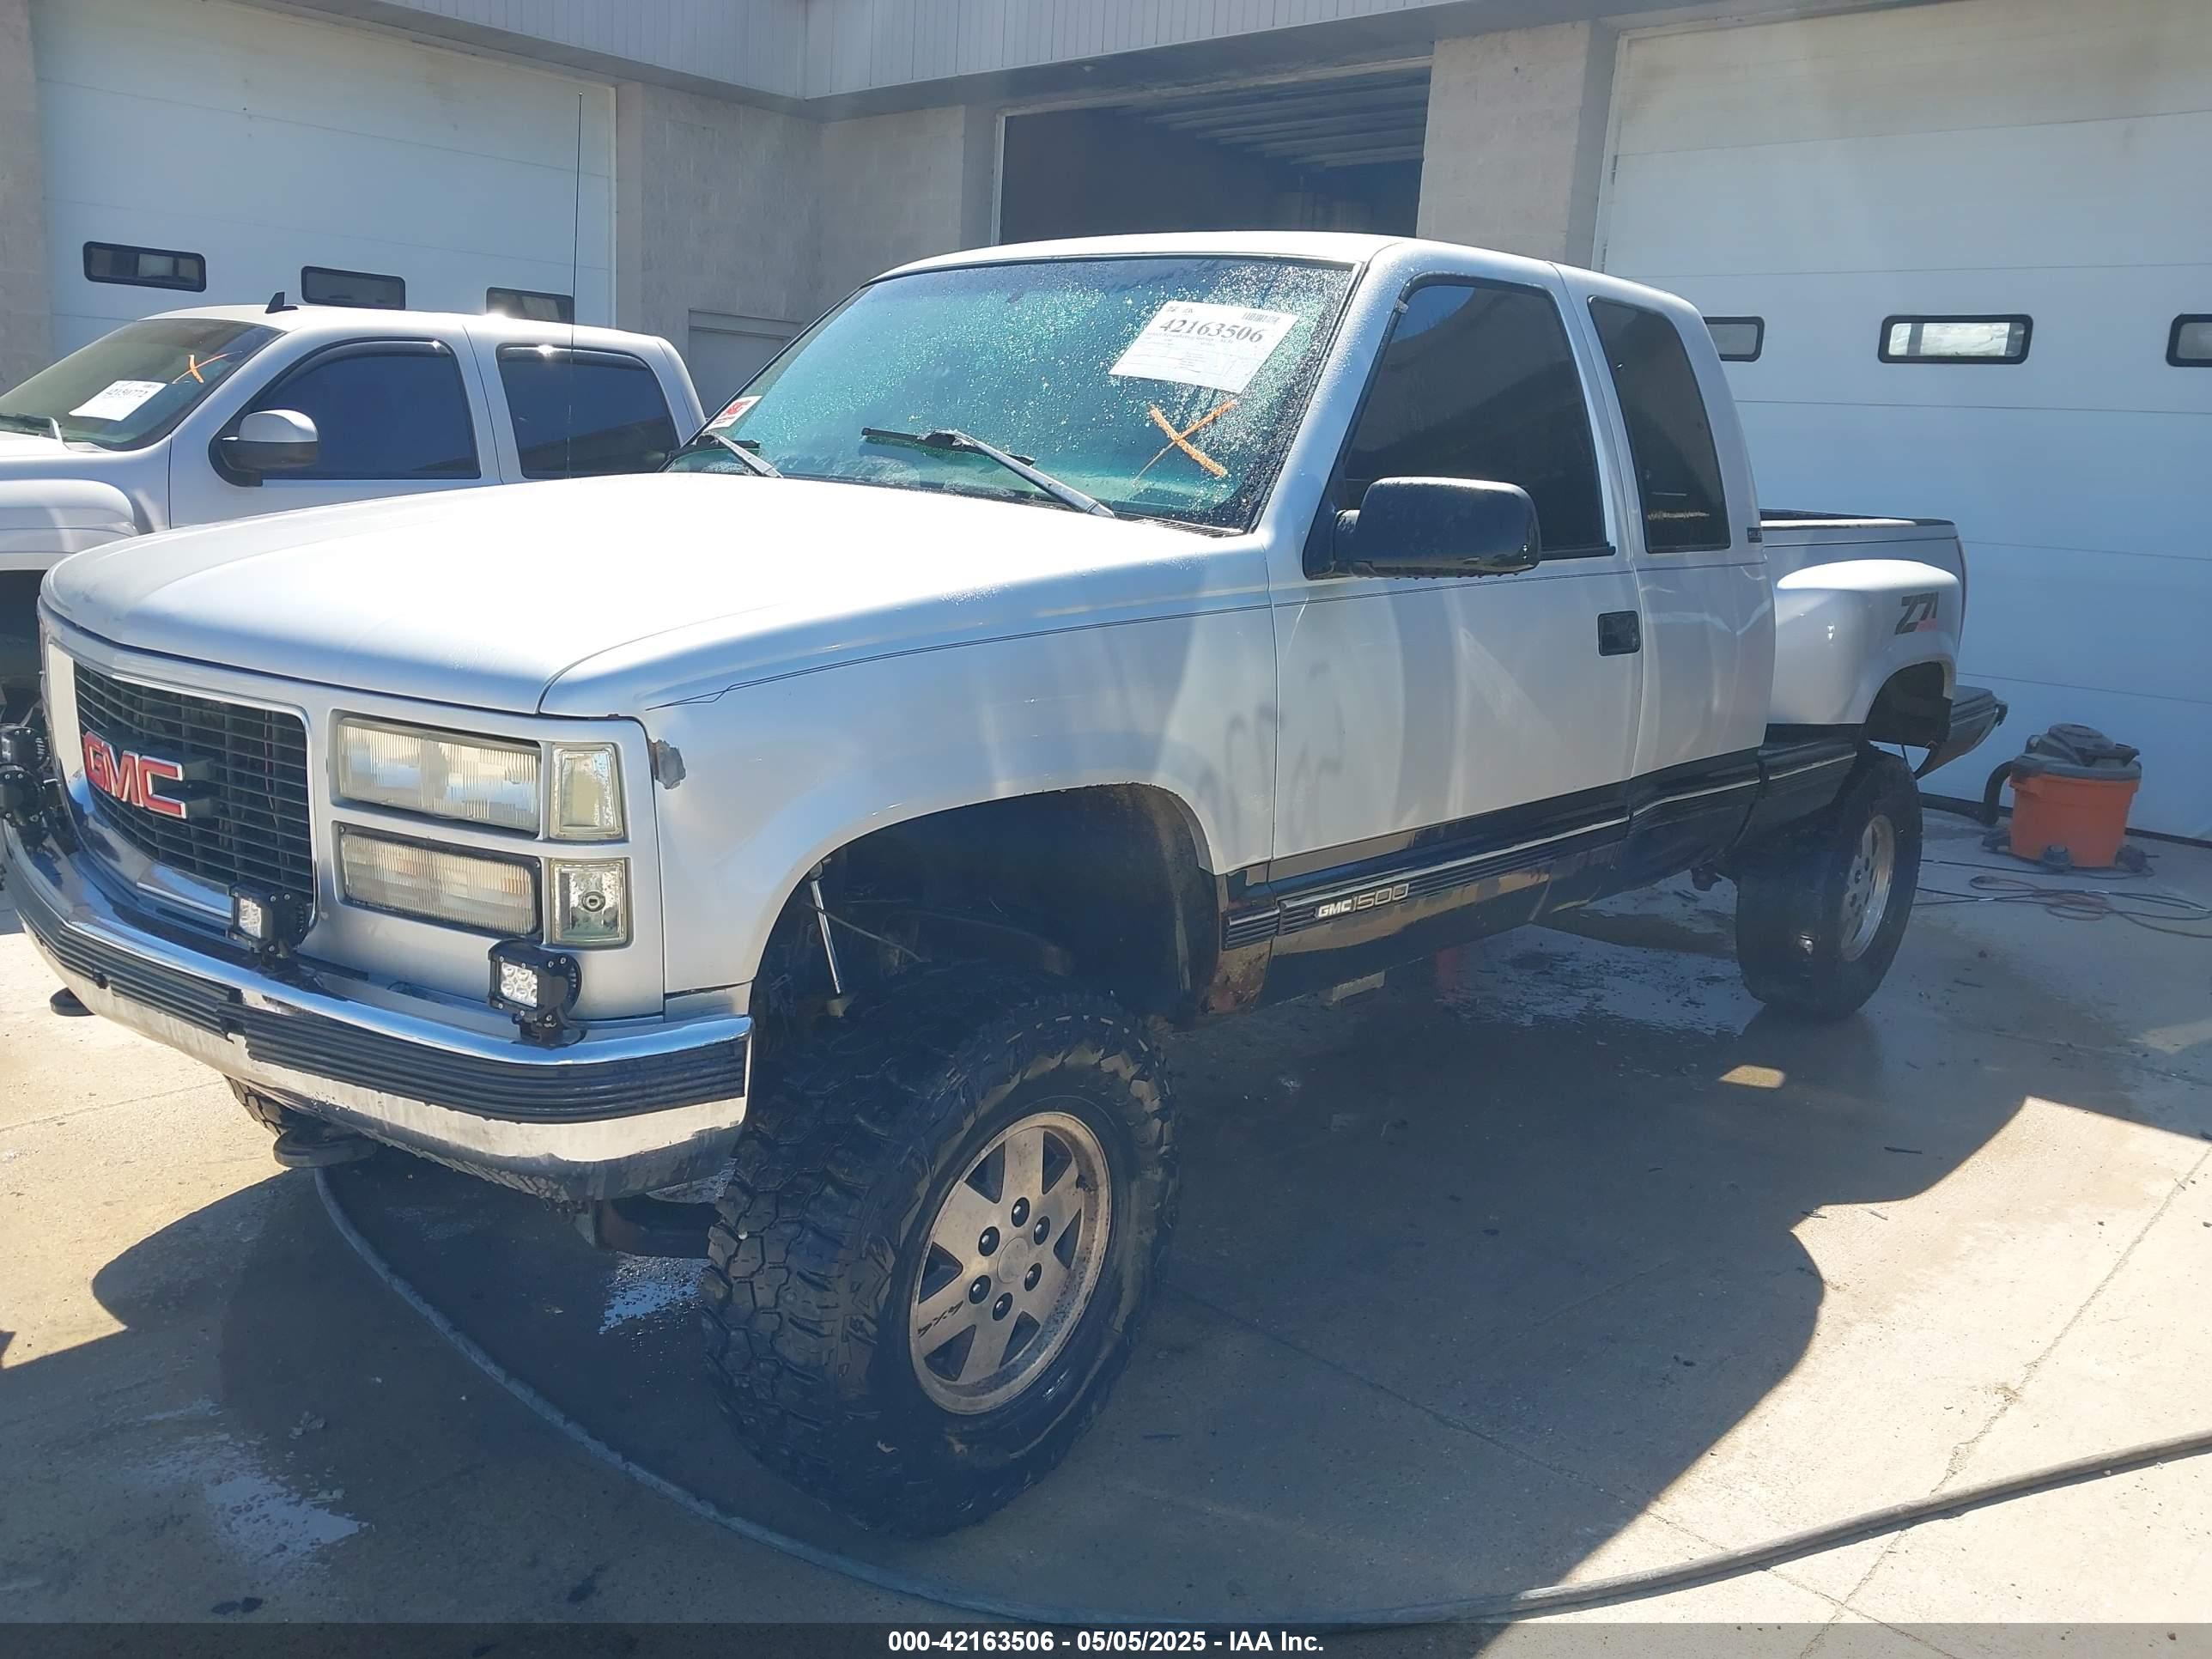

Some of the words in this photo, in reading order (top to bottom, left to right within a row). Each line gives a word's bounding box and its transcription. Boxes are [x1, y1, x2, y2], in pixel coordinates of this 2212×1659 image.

[1159, 318, 1267, 343] 42163506
[1895, 592, 1939, 635] Z71
[83, 731, 186, 819] GMC
[1318, 899, 1352, 918] GMC
[1352, 883, 1409, 912] 1500
